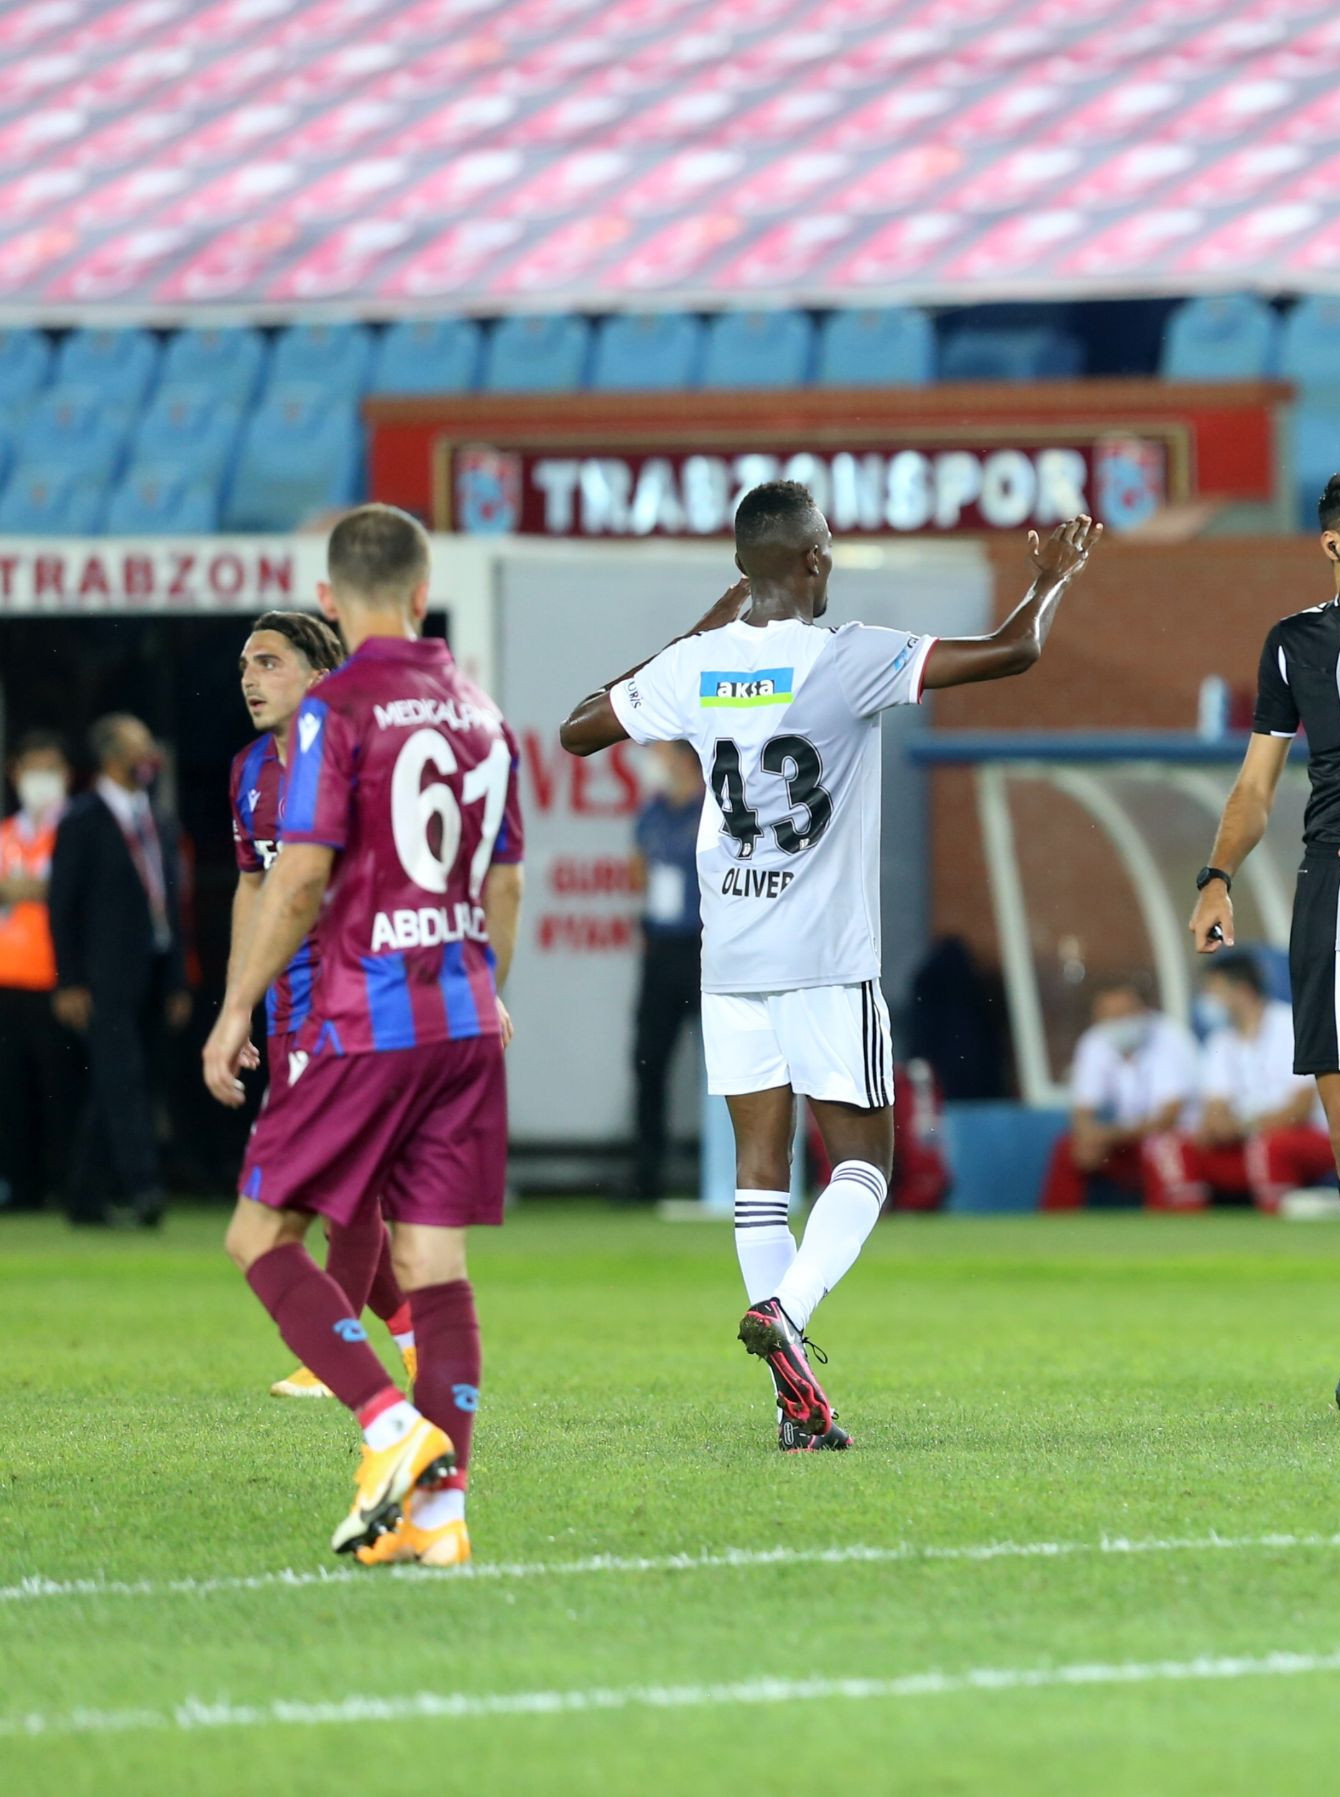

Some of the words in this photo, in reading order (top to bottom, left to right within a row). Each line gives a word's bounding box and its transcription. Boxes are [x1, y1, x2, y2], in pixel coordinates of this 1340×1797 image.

[0, 555, 292, 596] TRABZON
[717, 679, 774, 698] aksa
[390, 728, 511, 898] 61
[711, 734, 834, 860] 43
